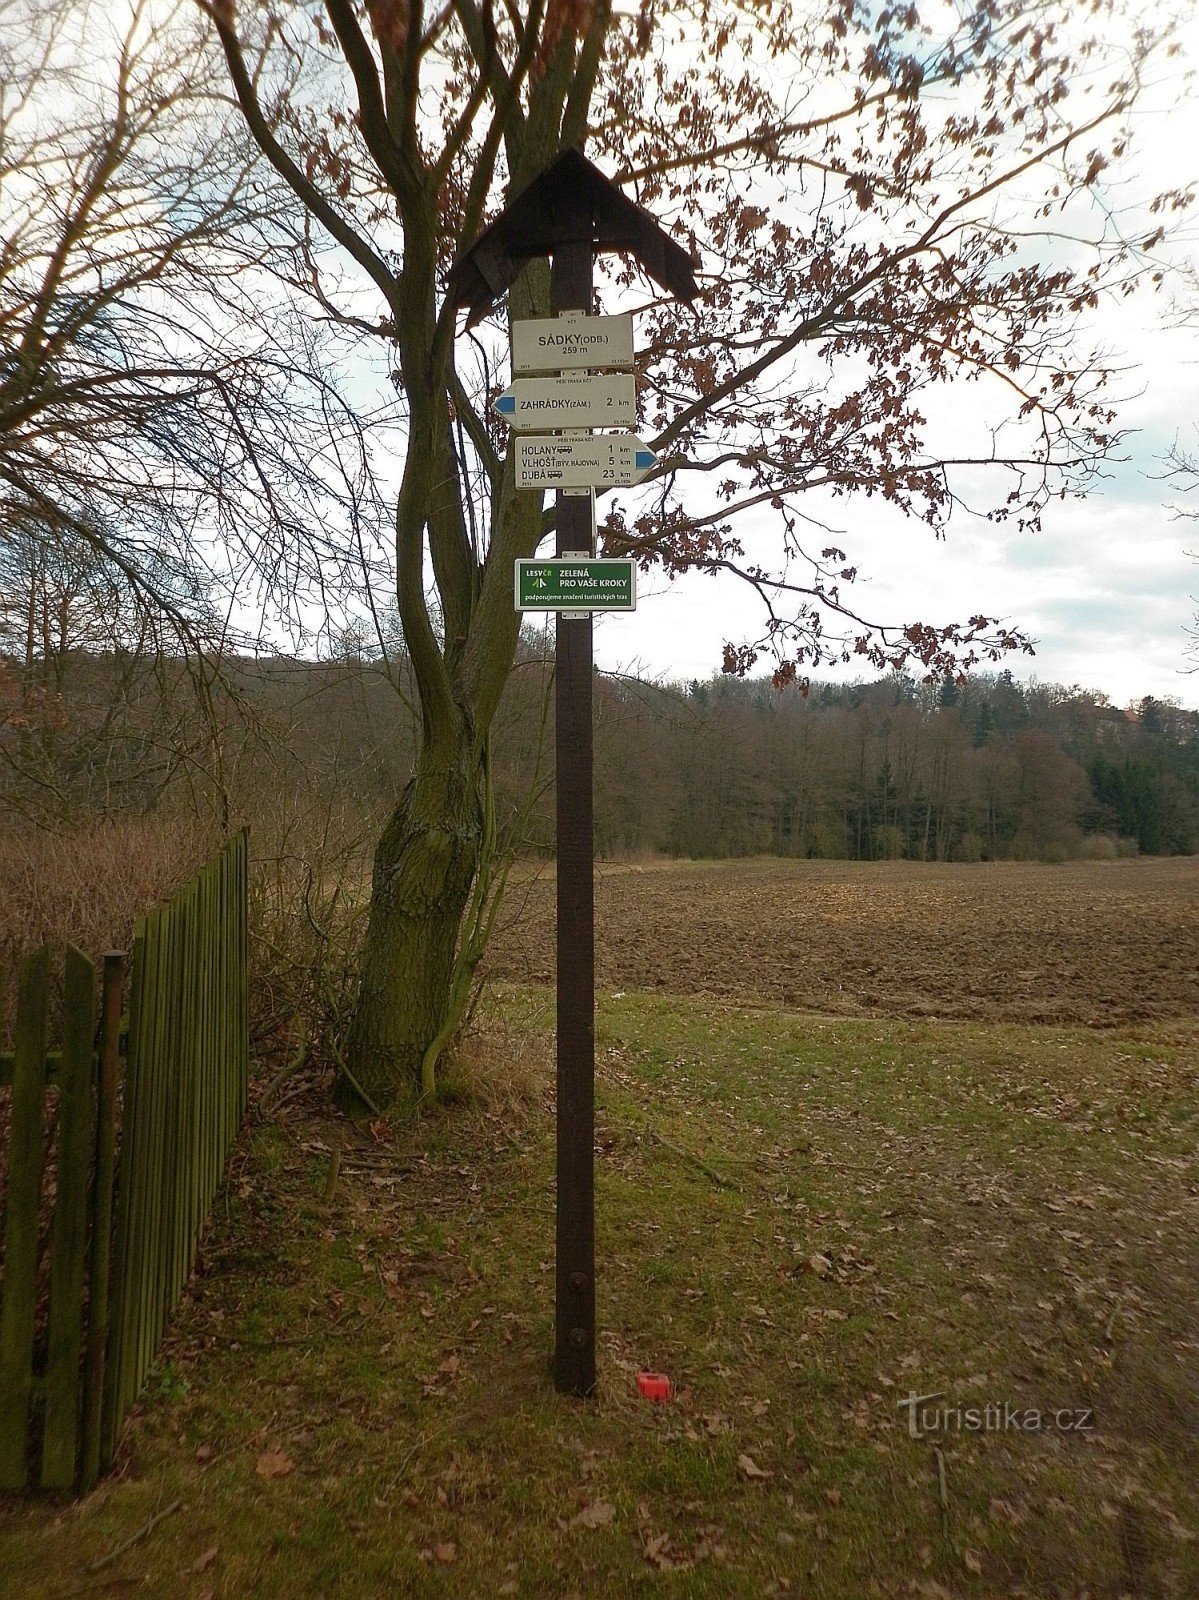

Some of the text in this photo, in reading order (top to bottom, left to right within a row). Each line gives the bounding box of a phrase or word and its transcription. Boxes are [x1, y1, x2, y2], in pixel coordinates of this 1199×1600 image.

[538, 333, 609, 346] SÁDKY(ODB.)
[607, 398, 612, 406] 2
[521, 446, 557, 455] HOLANY
[609, 457, 614, 465] 5
[522, 469, 546, 479] DUBÁ
[603, 470, 615, 478] 23
[560, 568, 589, 577] ZELENÁ
[560, 579, 576, 587] PRO
[578, 578, 598, 587] VAŠE
[585, 593, 616, 601] turistických
